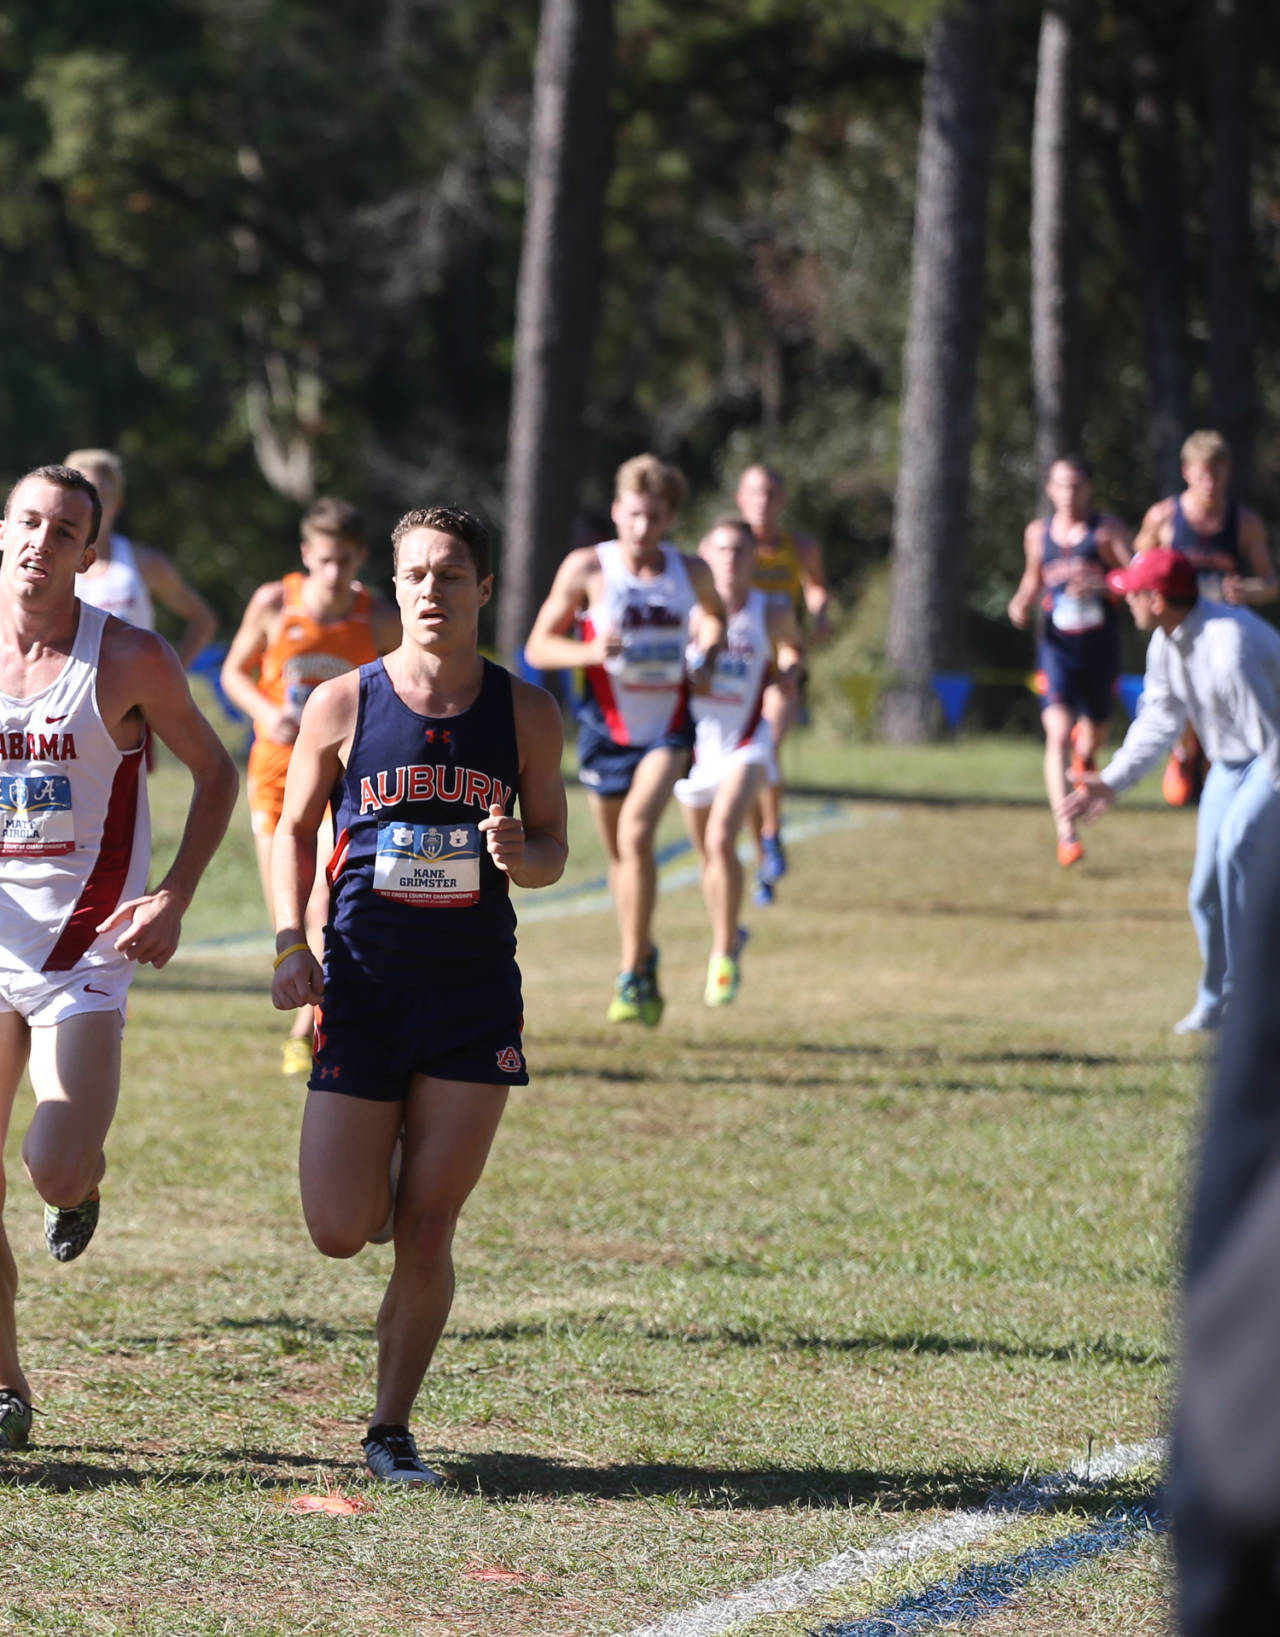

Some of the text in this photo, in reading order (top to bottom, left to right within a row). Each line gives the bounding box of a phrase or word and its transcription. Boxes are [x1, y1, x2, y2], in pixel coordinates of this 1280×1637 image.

[359, 764, 512, 815] AUBURN
[413, 868, 445, 879] KANE
[399, 877, 457, 888] GRIMSTER
